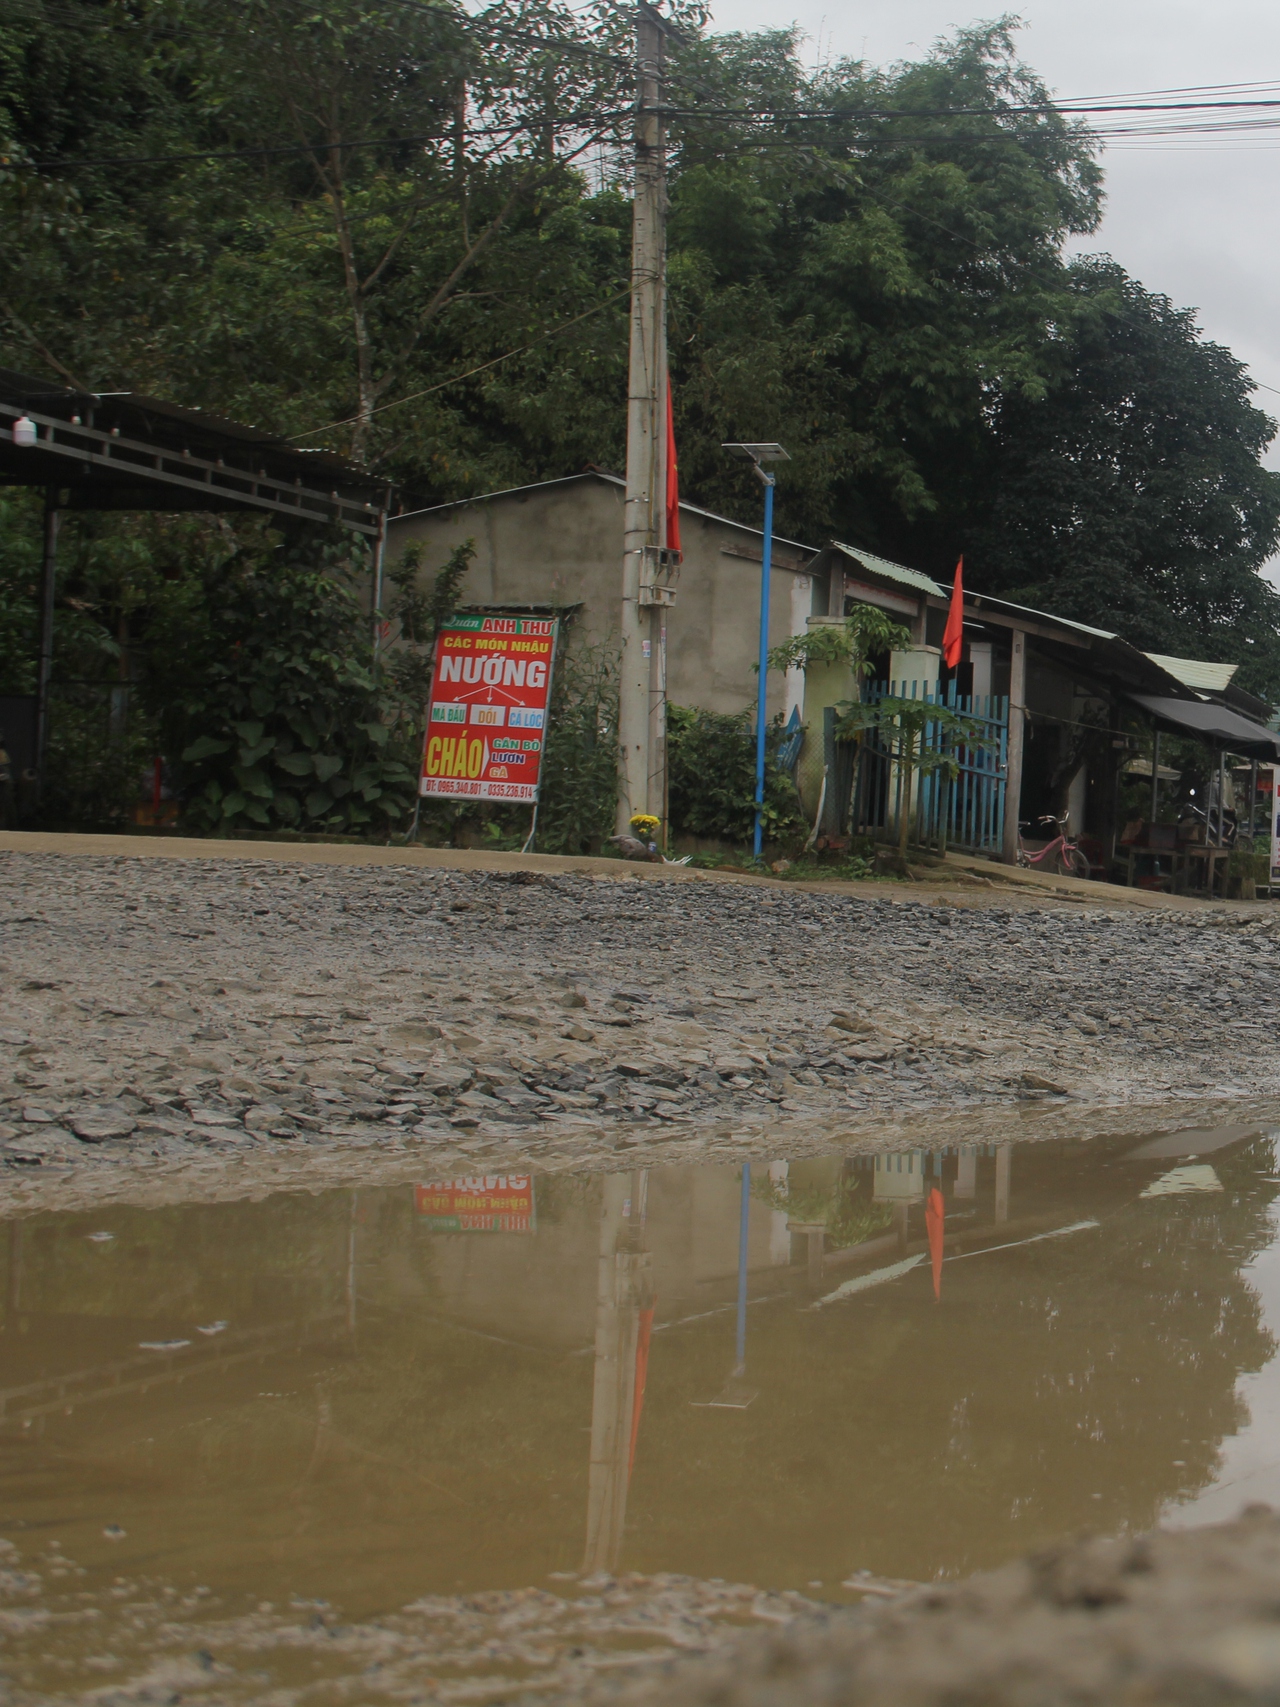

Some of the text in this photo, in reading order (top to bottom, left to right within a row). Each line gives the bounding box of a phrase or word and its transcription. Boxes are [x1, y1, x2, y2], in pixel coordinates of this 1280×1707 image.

[481, 617, 517, 634] ANH
[520, 619, 555, 636] THƯ
[444, 635, 549, 655] CÁC MÓN NHẬU
[438, 652, 547, 688] NƯỚNG
[523, 711, 543, 729] LÓC
[492, 736, 521, 751] GÂN
[426, 729, 483, 779] CHÁO
[490, 751, 526, 765] LƯƠN
[488, 765, 509, 779] GÀ
